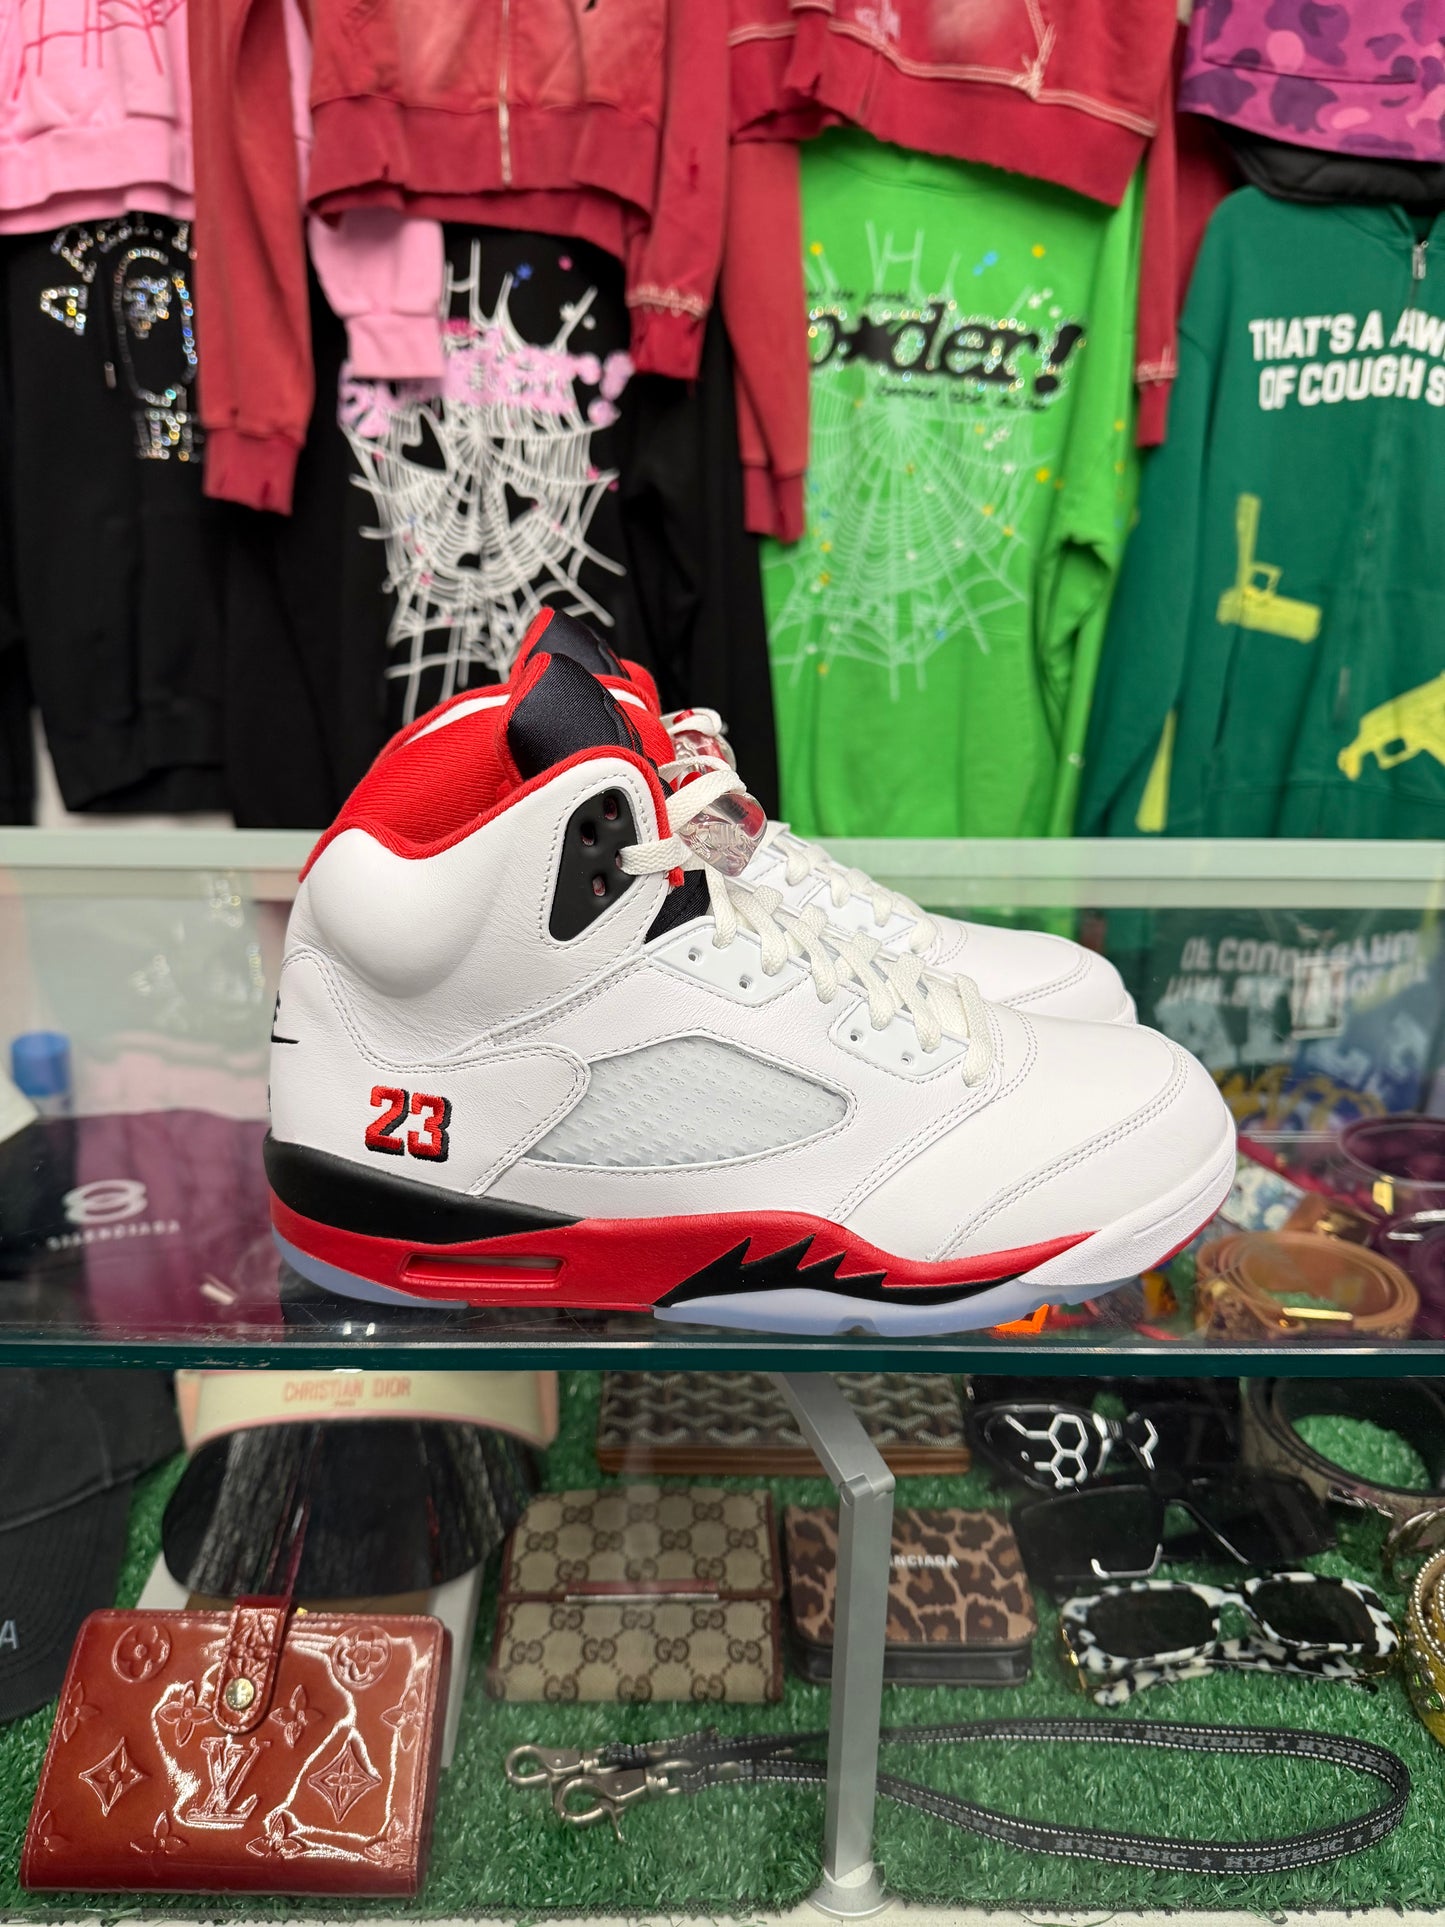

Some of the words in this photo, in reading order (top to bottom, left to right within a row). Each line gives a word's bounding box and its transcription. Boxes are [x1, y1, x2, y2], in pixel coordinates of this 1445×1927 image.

[1248, 313, 1356, 361] THAT'S
[1356, 309, 1384, 351] A
[1389, 307, 1445, 362] AW
[1259, 365, 1297, 411] OF
[1298, 353, 1427, 406] COUGH
[365, 1085, 452, 1163] 23
[283, 1378, 364, 1404] CHRISTIAN
[373, 1376, 412, 1399] DIOR
[1146, 1729, 1267, 1749] HYSTERIC
[1055, 1837, 1189, 1866] HYSTERIC
[1224, 1837, 1346, 1869] HYSTERIC
